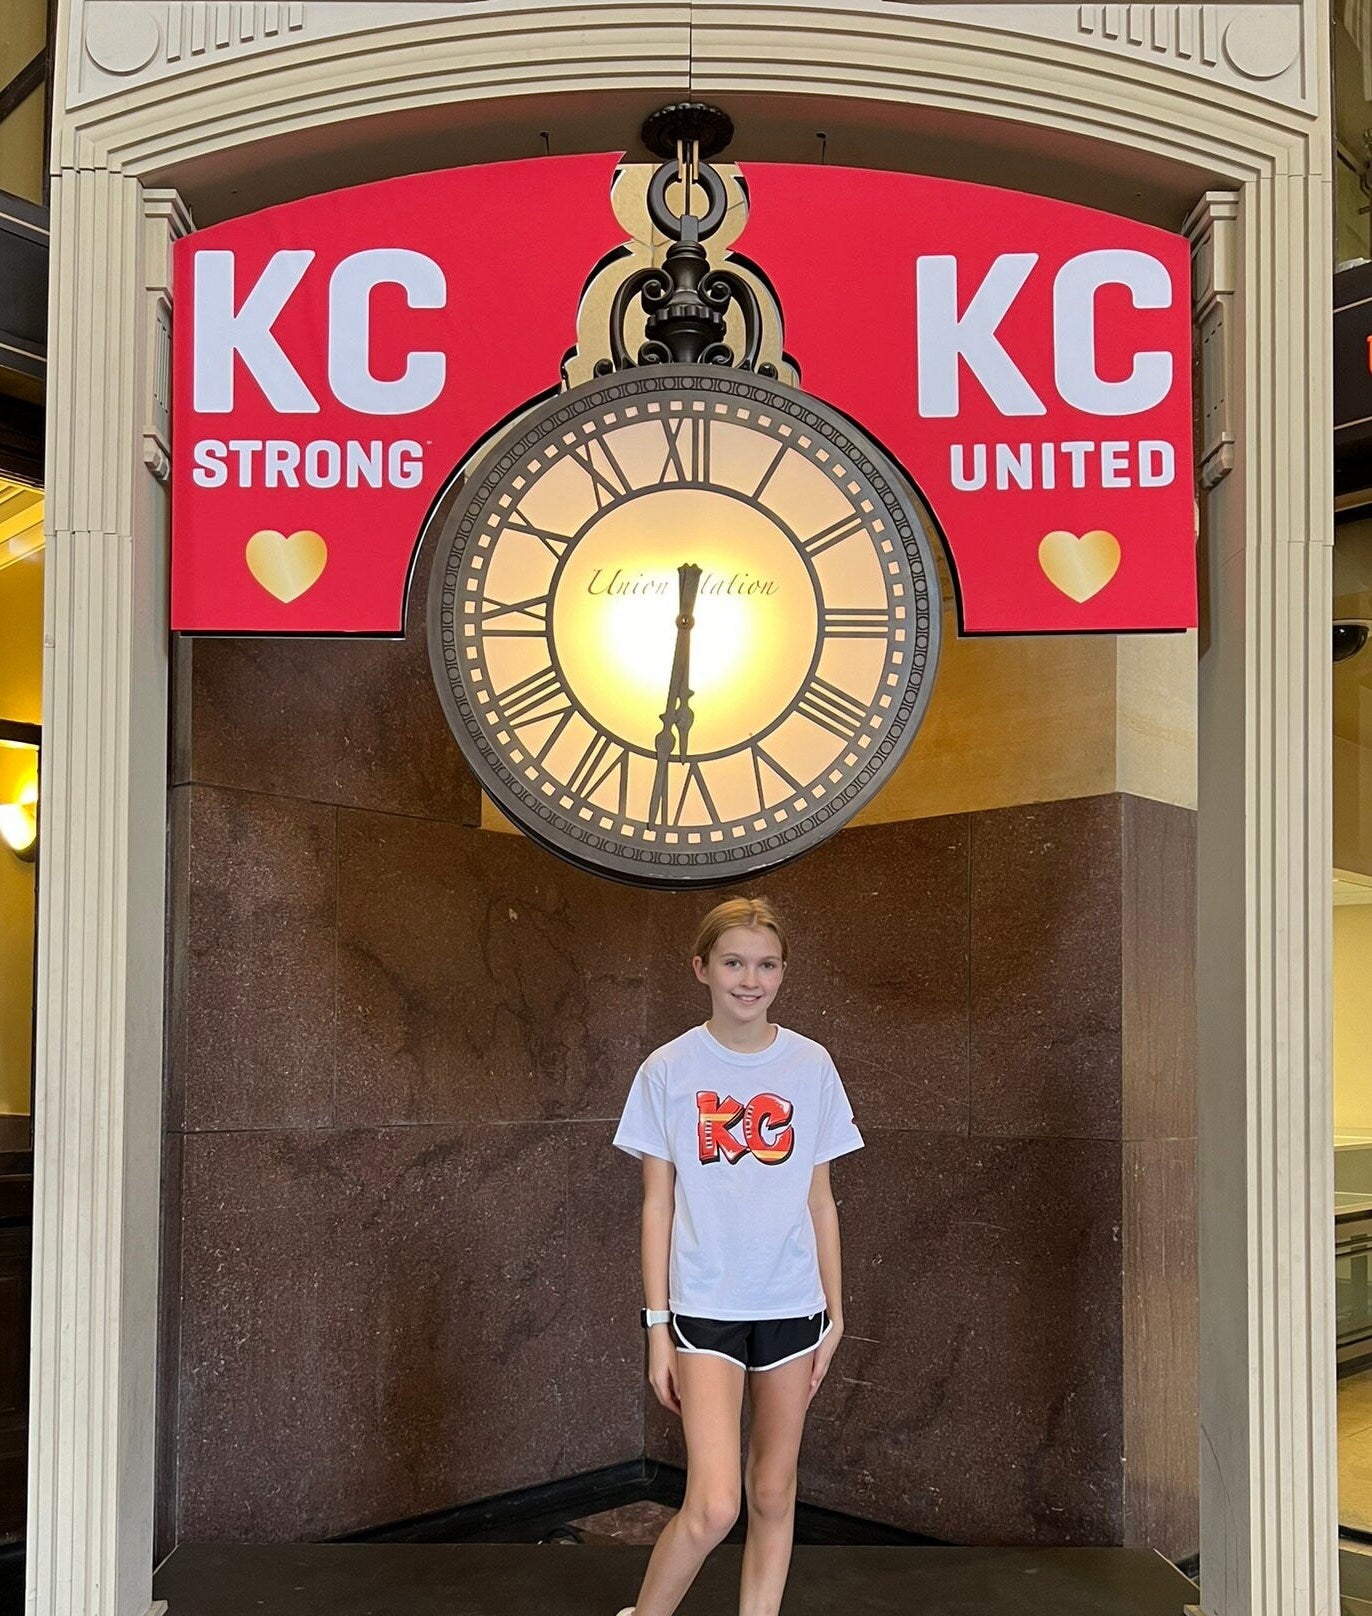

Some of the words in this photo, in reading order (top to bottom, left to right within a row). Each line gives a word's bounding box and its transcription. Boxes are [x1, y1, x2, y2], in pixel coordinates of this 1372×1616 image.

[193, 248, 447, 416] KC
[916, 249, 1173, 418] KC
[192, 439, 424, 489] STRONG
[567, 434, 634, 511] XI
[659, 417, 711, 483] XII
[950, 440, 1175, 492] UNITED
[502, 507, 573, 561] X
[801, 512, 867, 559] II
[587, 568, 669, 596] Union
[700, 572, 780, 596] tation
[481, 595, 548, 638] IX
[823, 608, 889, 639] III
[696, 1090, 794, 1166] KC
